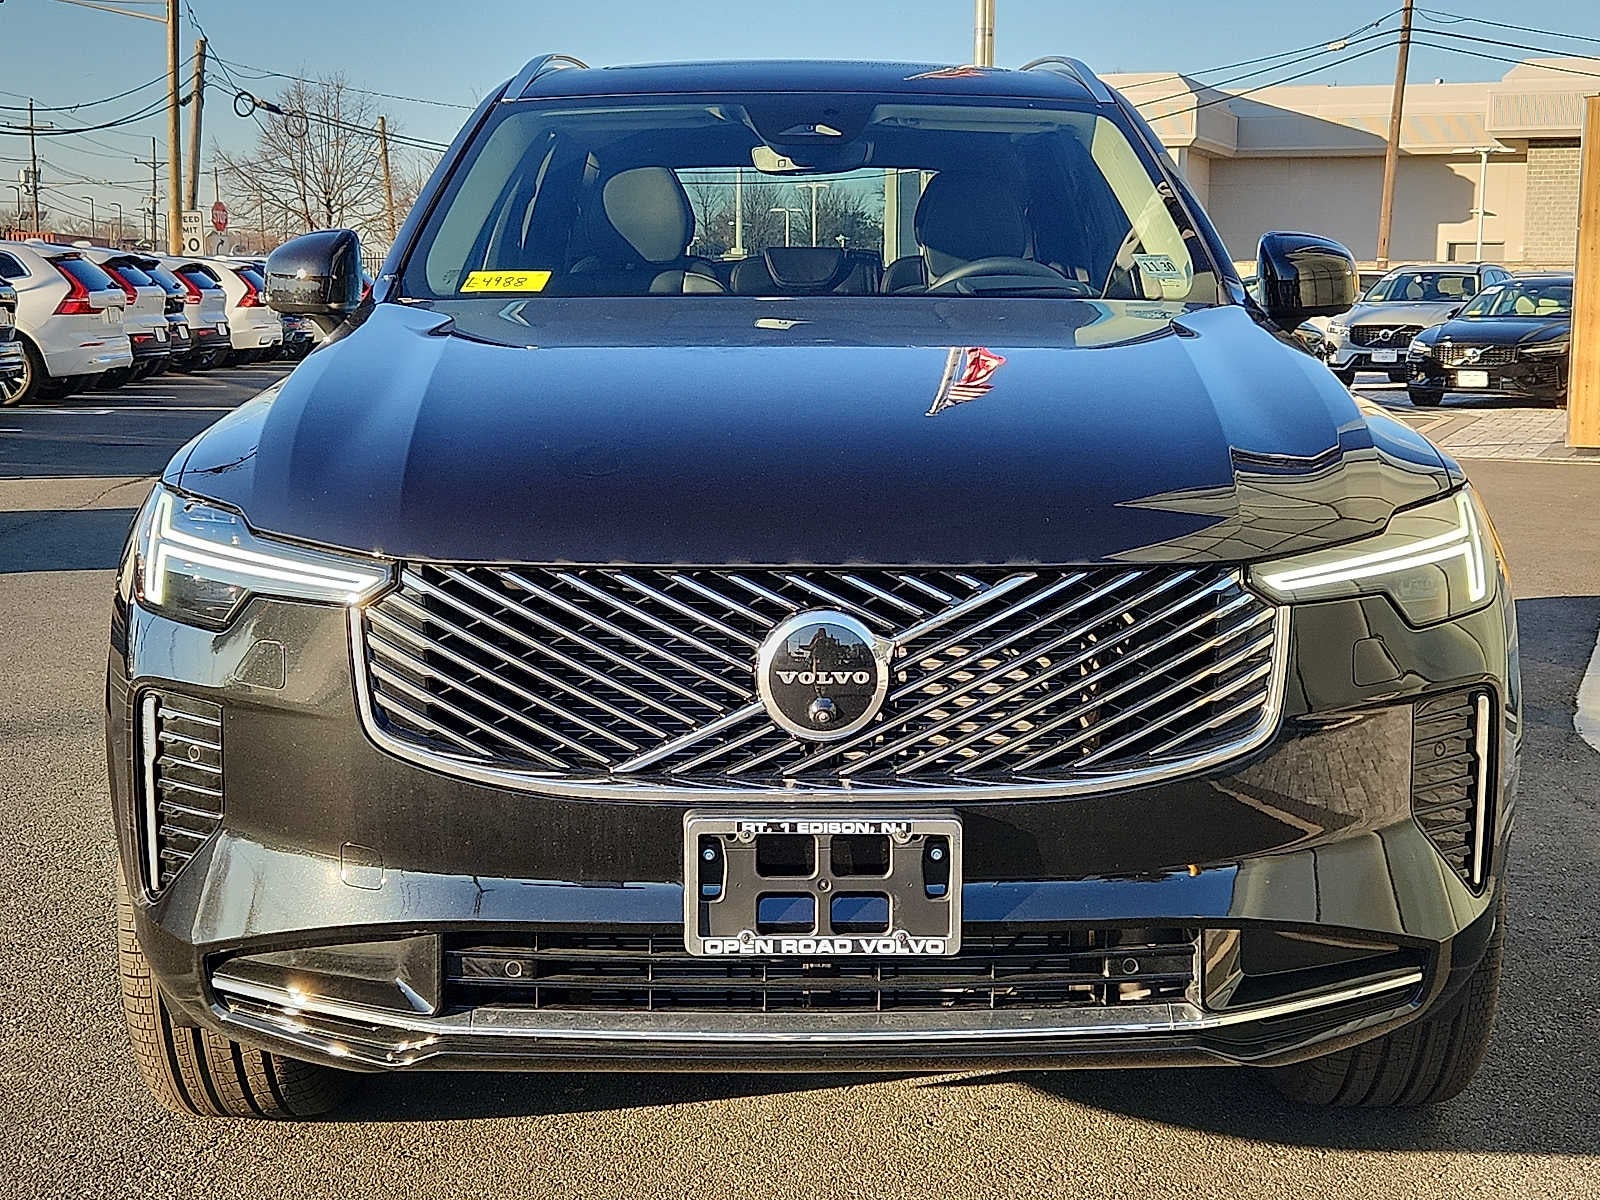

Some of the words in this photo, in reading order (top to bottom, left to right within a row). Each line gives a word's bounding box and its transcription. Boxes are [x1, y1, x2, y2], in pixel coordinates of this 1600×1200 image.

[183, 215, 200, 223] EED
[183, 226, 198, 234] MIT
[776, 671, 870, 685] VOLVO
[797, 822, 875, 834] EDISON,
[704, 939, 777, 954] OPEN
[781, 939, 853, 954] ROAD
[857, 939, 945, 954] VOLVO
